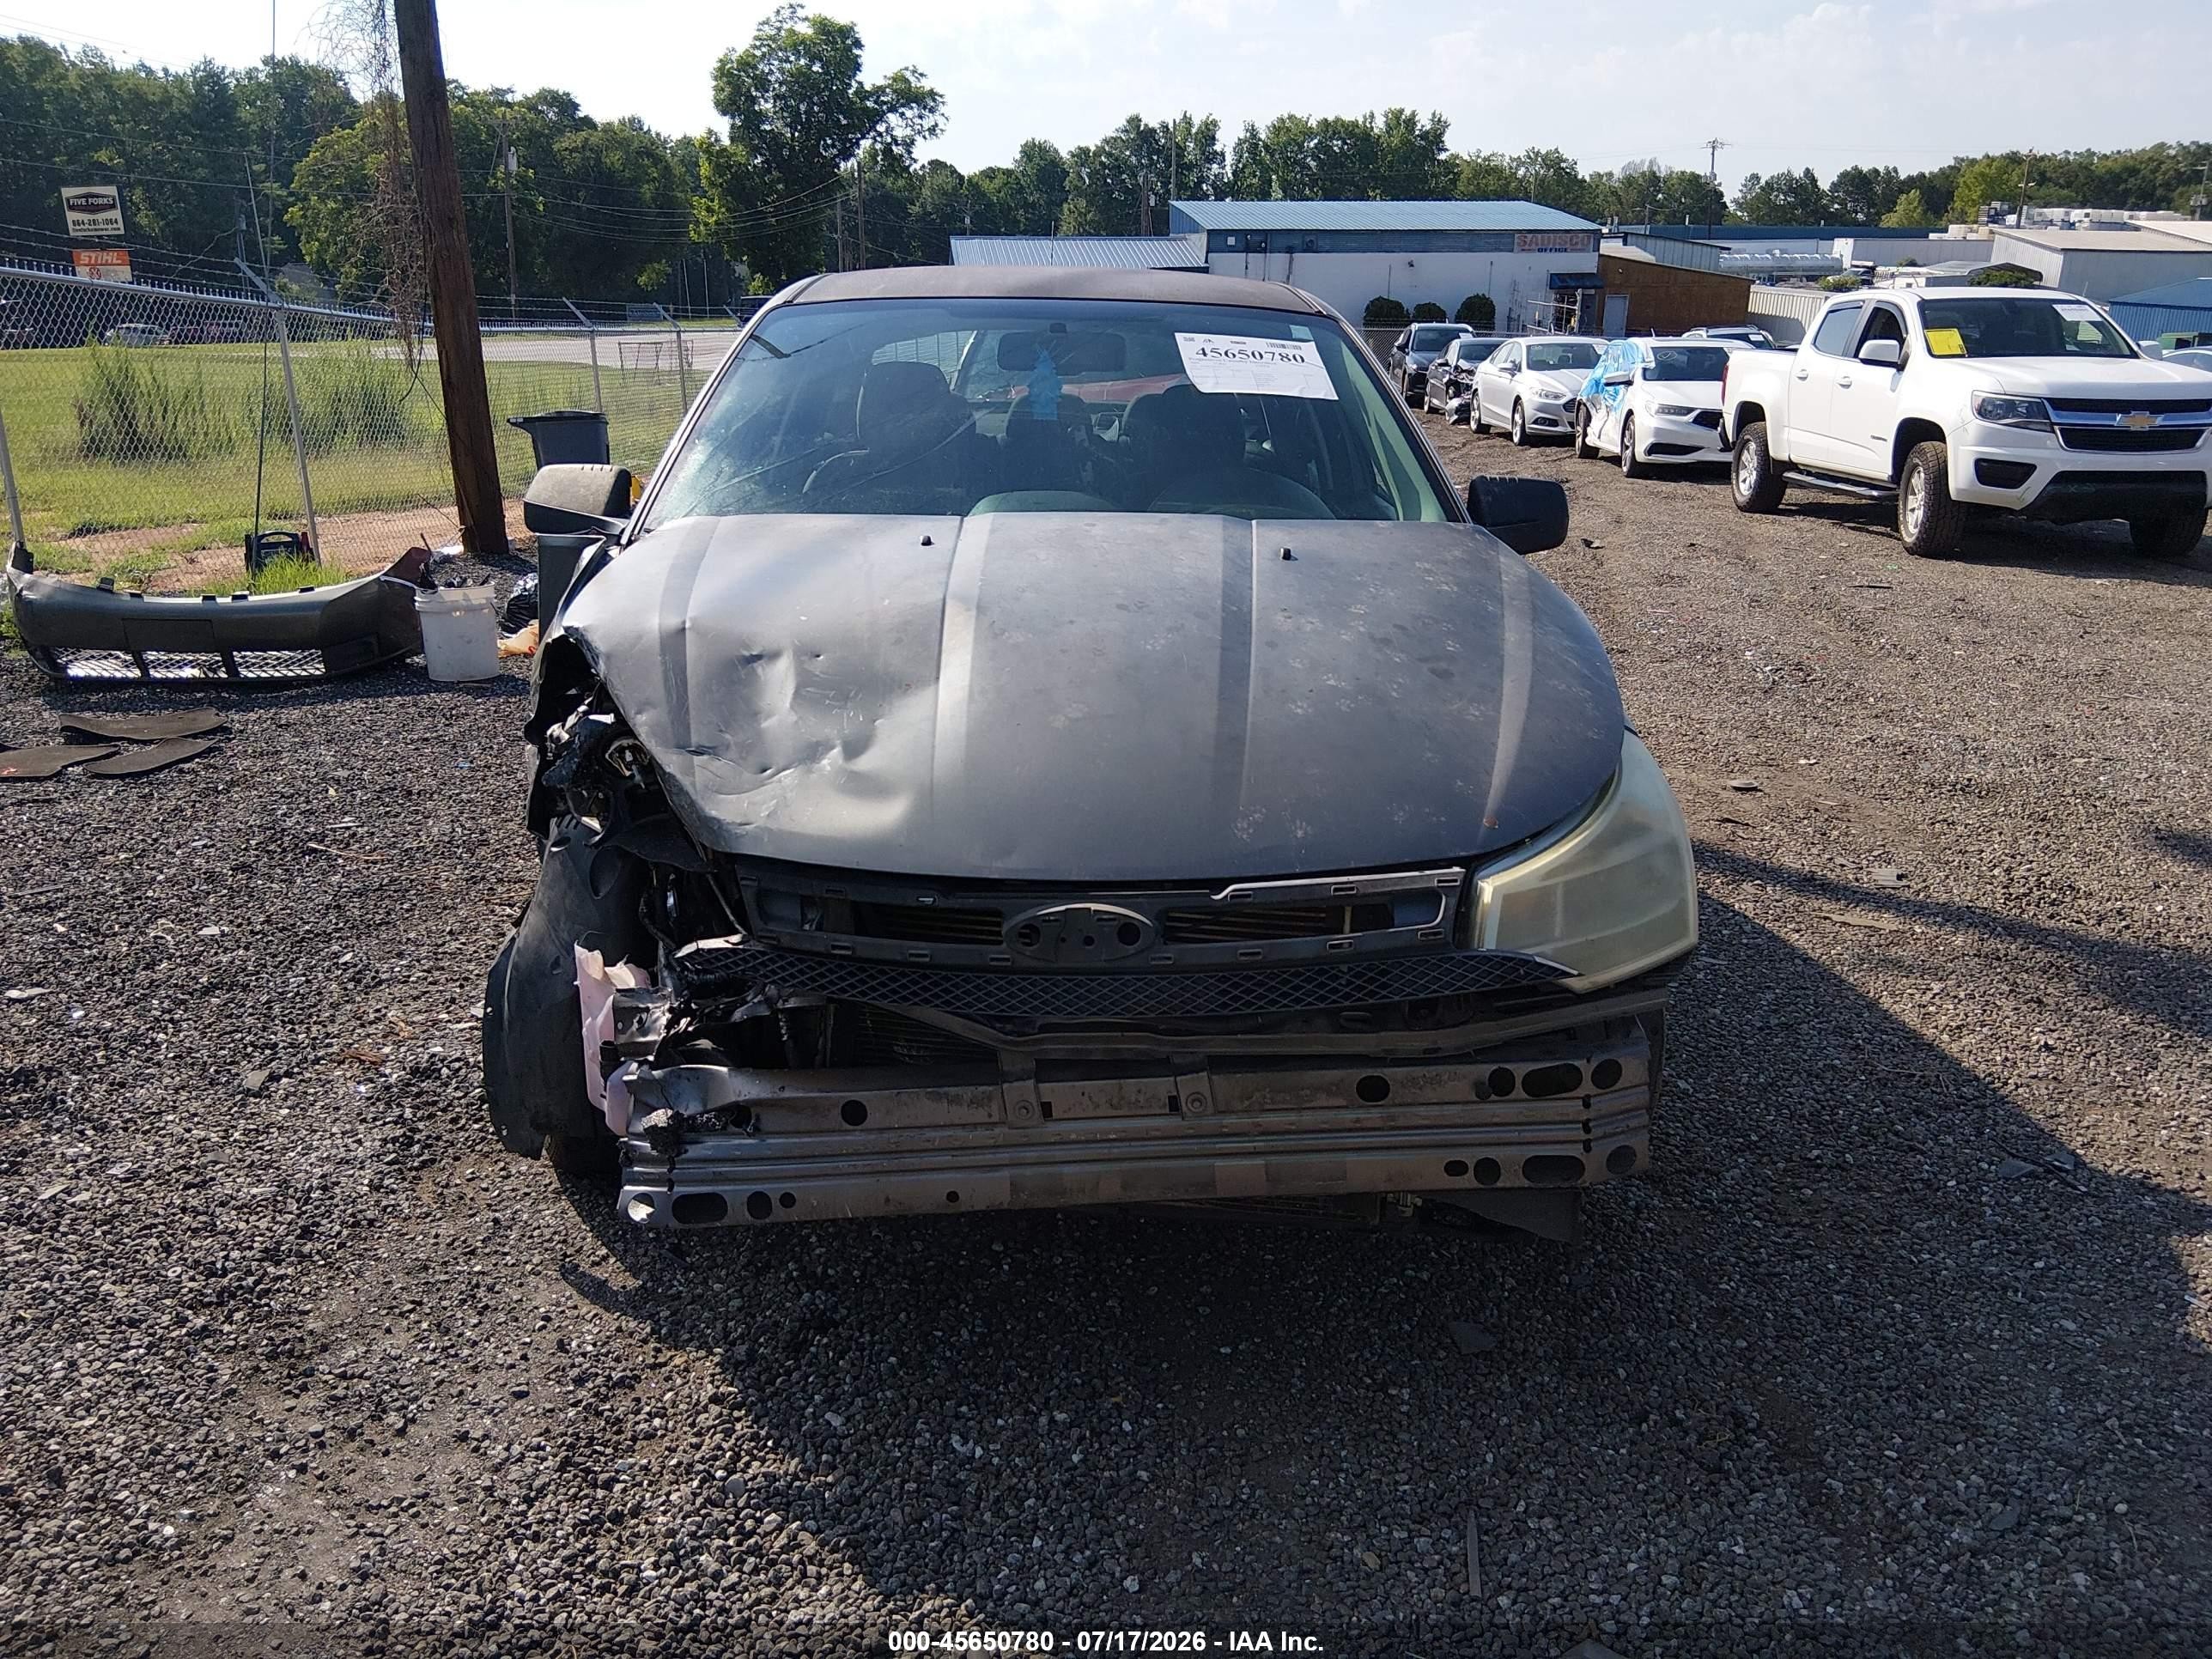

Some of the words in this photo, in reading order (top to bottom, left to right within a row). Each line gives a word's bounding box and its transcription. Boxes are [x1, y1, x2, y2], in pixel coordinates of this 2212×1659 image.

[70, 198, 87, 206] FIVE
[88, 197, 114, 205] FORKS
[72, 218, 118, 228] 864-281-1064
[80, 252, 122, 264] STIHL
[1195, 346, 1306, 364] 45650780
